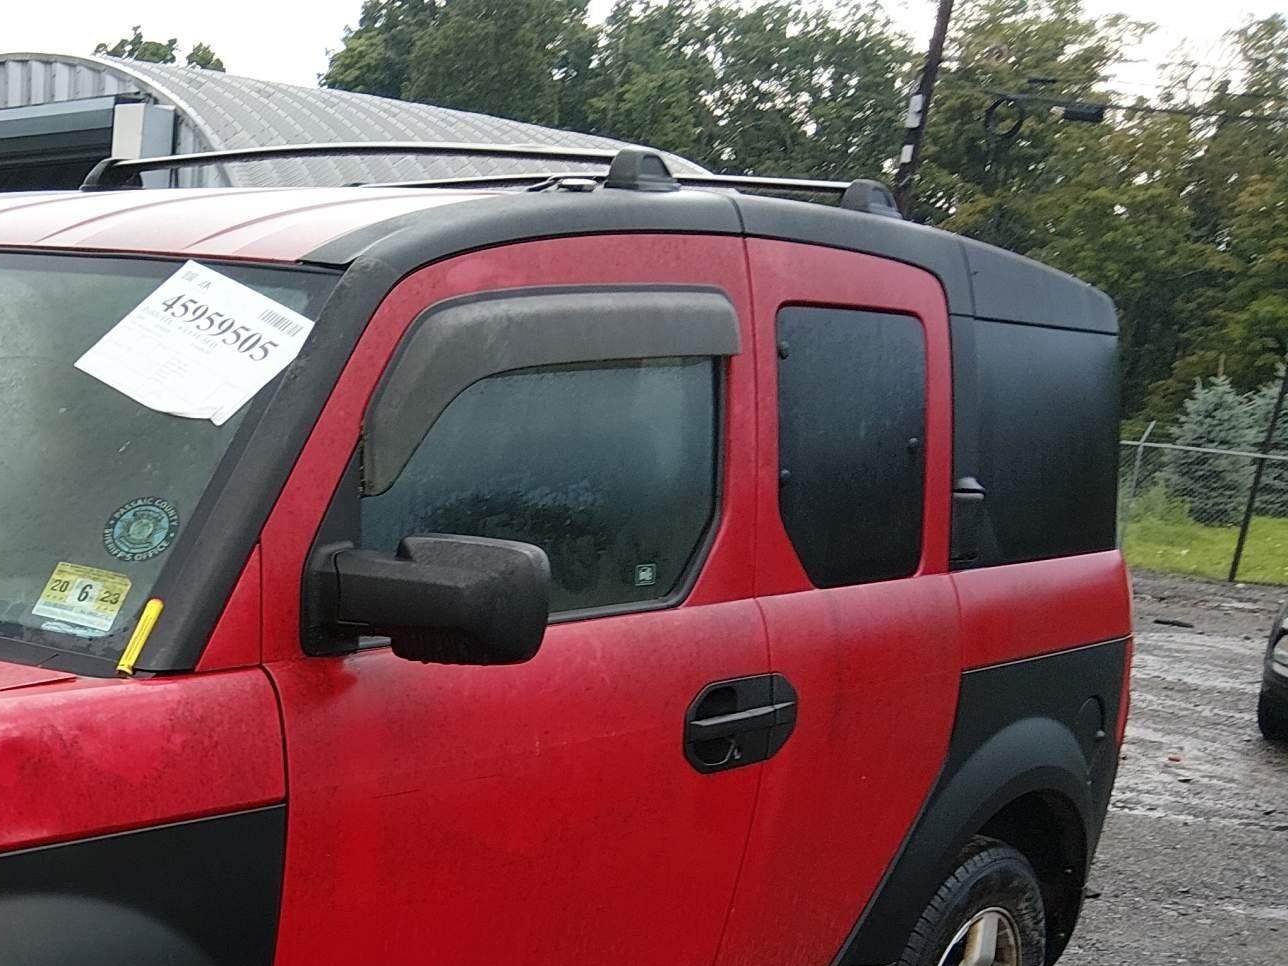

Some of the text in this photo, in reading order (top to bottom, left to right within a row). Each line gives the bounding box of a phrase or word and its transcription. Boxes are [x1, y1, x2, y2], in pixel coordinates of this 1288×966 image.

[161, 293, 279, 361] 45959505
[50, 580, 121, 605] 20 6 23
